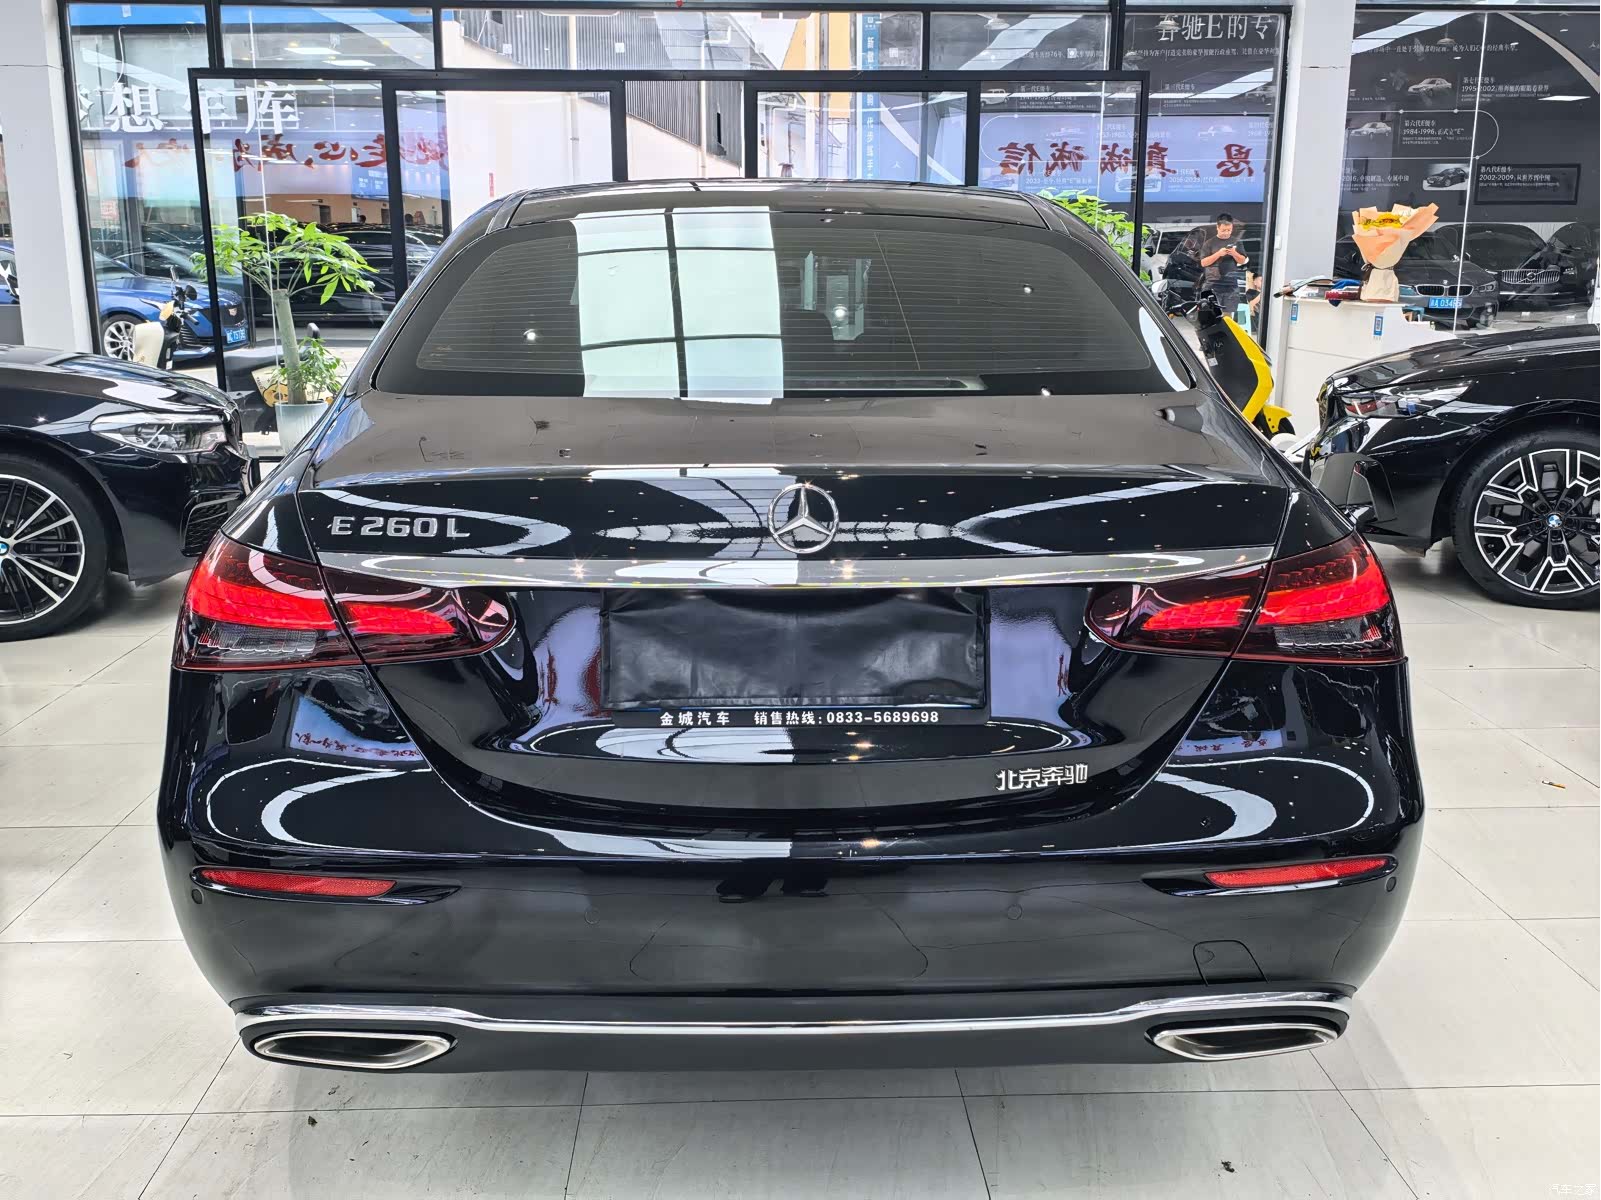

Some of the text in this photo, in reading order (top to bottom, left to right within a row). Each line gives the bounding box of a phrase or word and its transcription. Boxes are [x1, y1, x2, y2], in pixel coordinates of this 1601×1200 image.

[1157, 13, 1281, 41] 奔驰E的专
[330, 515, 471, 539] E 260 L
[659, 711, 732, 726] 金城汽车
[994, 763, 1089, 792] 北京奔驰
